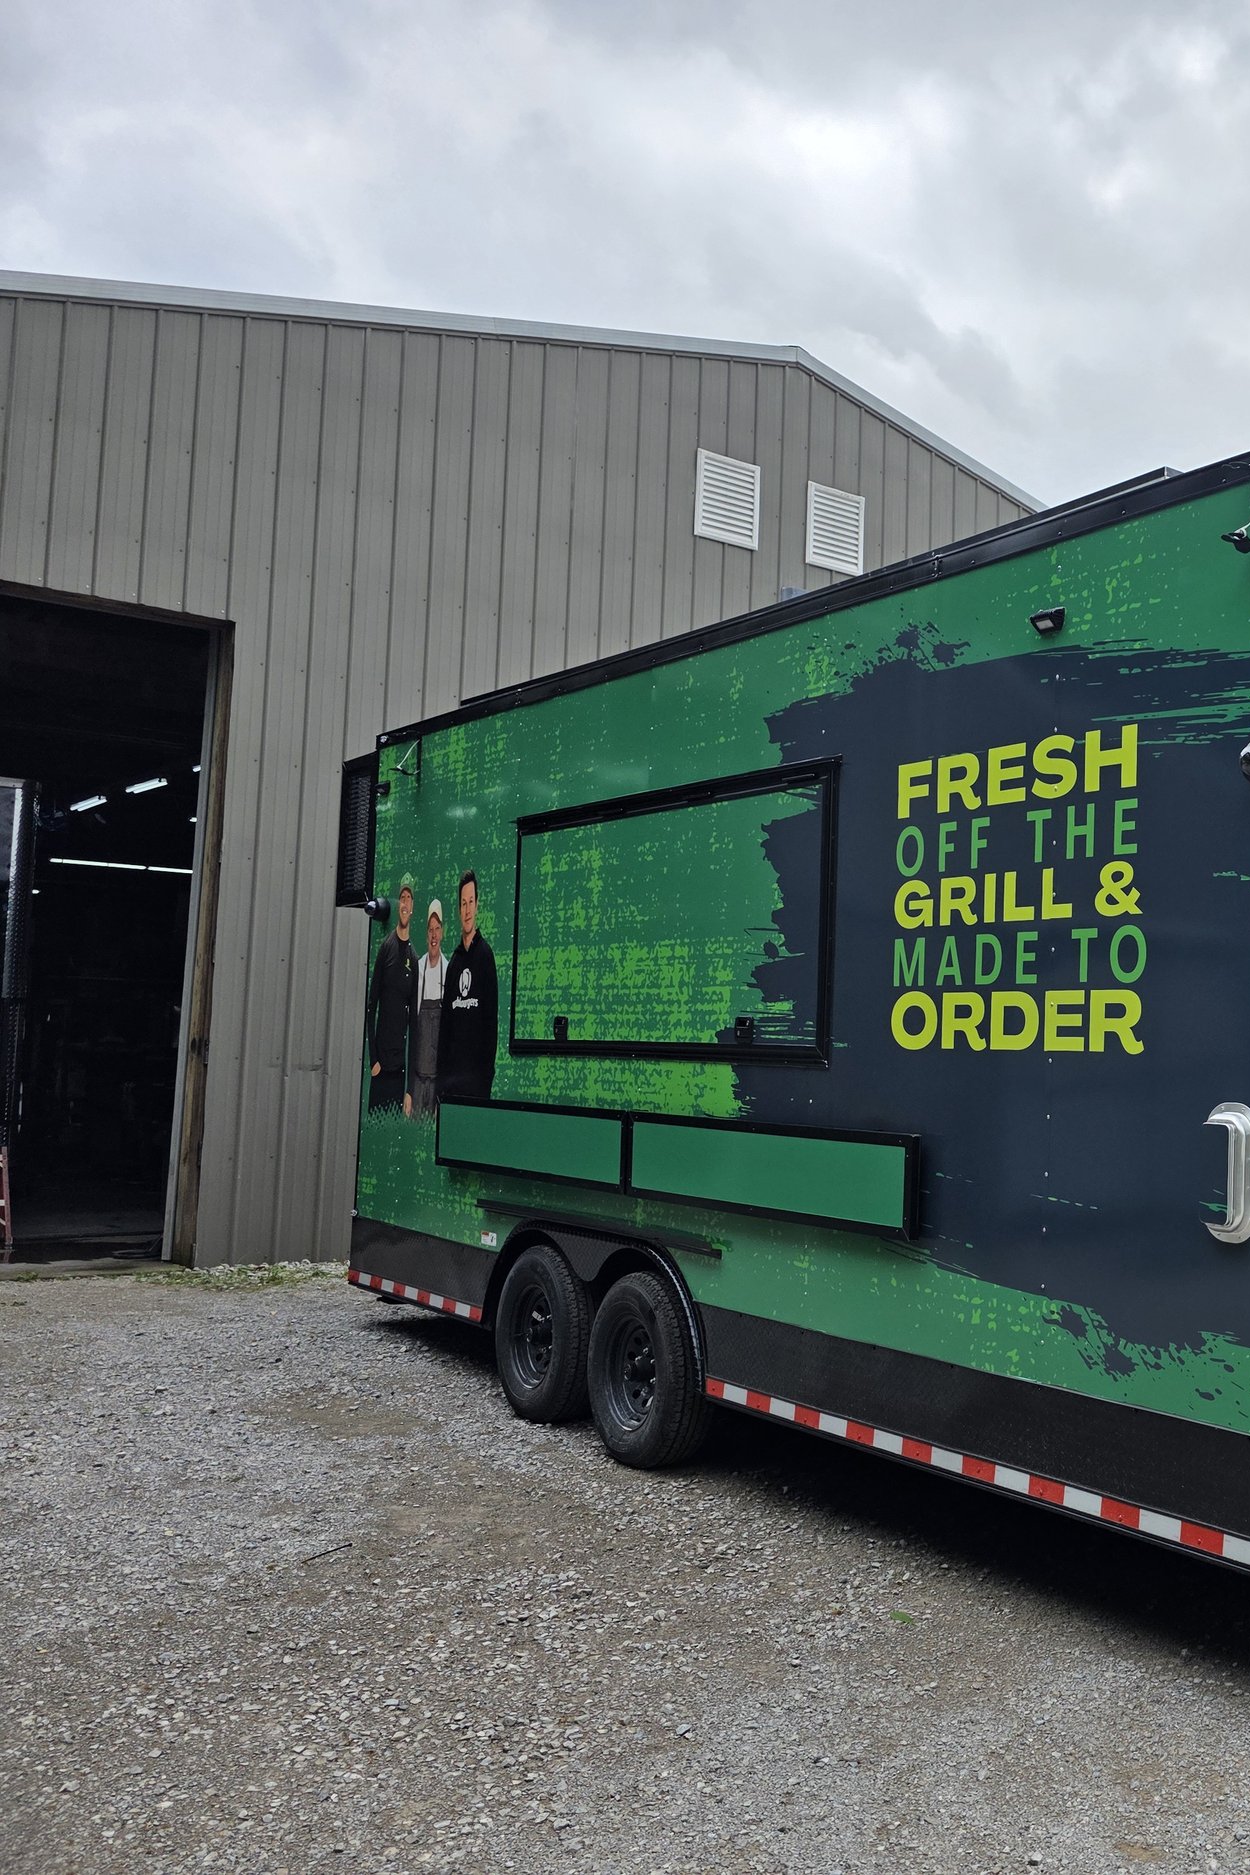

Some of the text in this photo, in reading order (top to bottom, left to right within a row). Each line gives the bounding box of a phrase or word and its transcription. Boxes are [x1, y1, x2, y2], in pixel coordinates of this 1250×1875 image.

[898, 723, 1138, 819] FRESH
[896, 798, 1138, 877] OFF THE
[894, 860, 1143, 930] GRILL &
[893, 924, 1147, 987] MADE TO
[890, 989, 1145, 1055] ORDER
